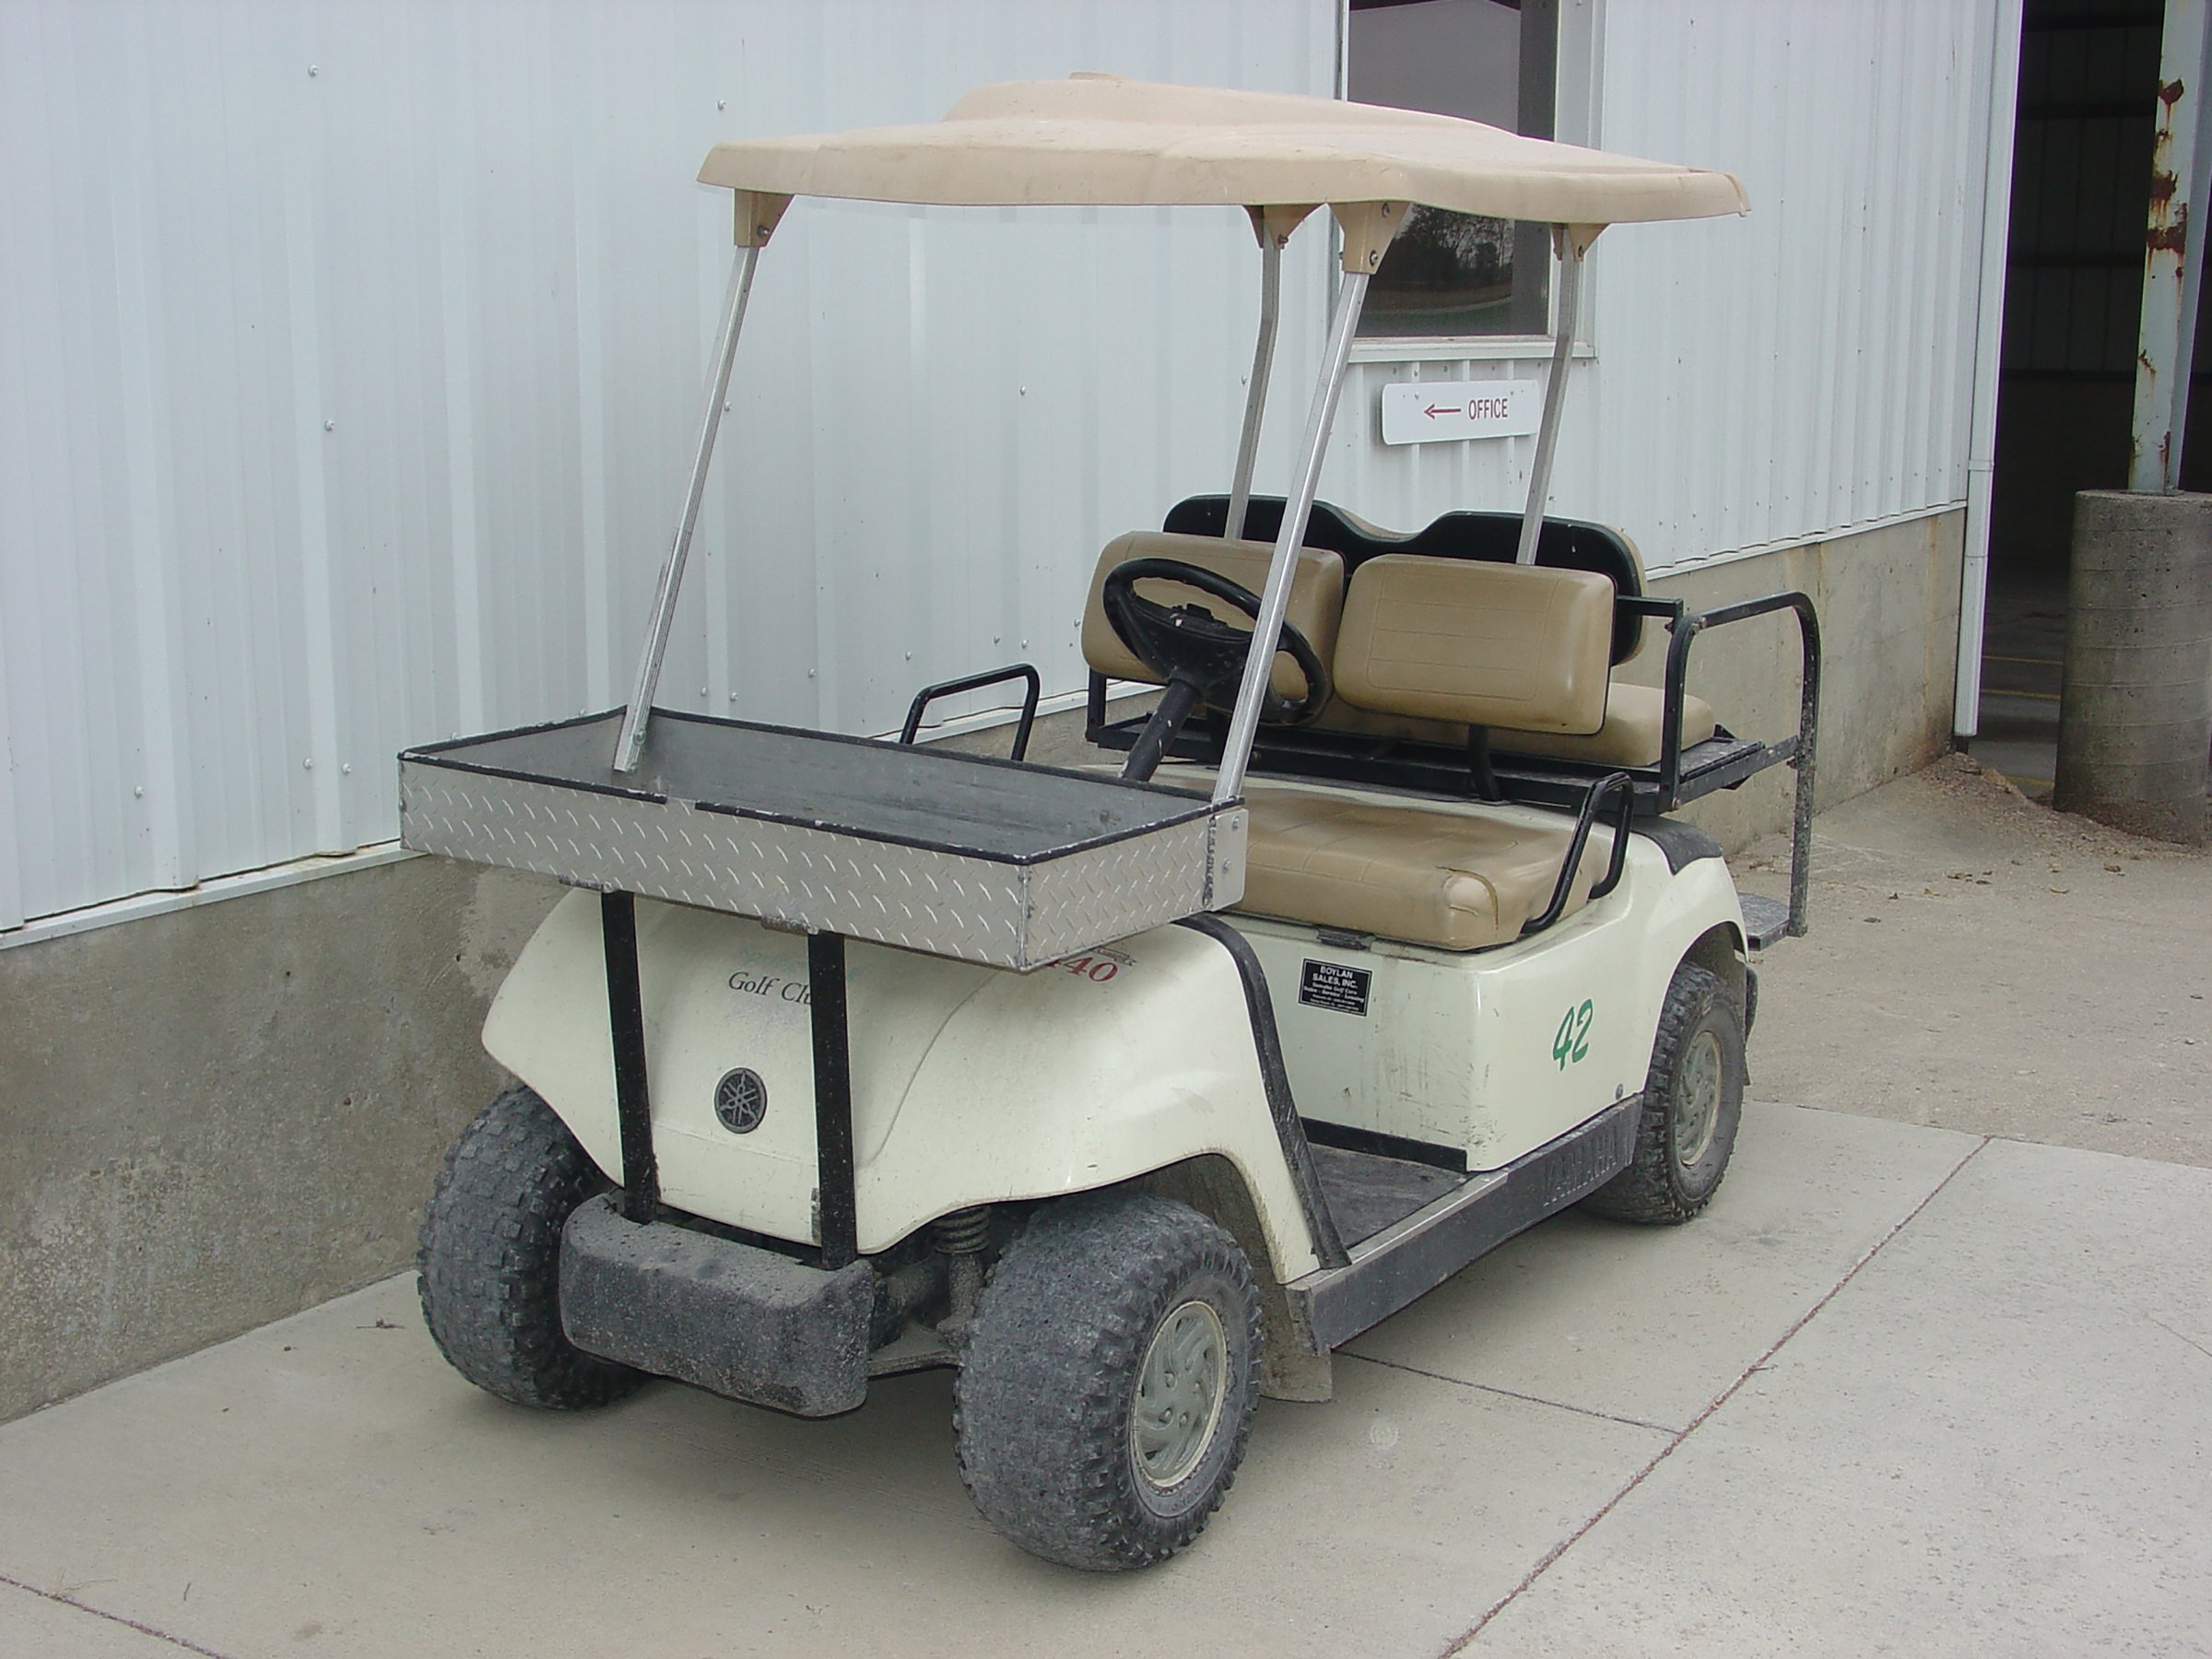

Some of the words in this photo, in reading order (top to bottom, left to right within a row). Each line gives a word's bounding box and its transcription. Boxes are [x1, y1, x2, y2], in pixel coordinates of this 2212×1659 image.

[1468, 398, 1508, 420] OFFICE
[1312, 973, 1341, 986] SALES,
[1342, 980, 1359, 989] INC.
[1320, 966, 1353, 979] BOYLAN
[728, 971, 781, 996] Golf
[781, 982, 812, 1005] Clu
[1552, 998, 1593, 1072] 42
